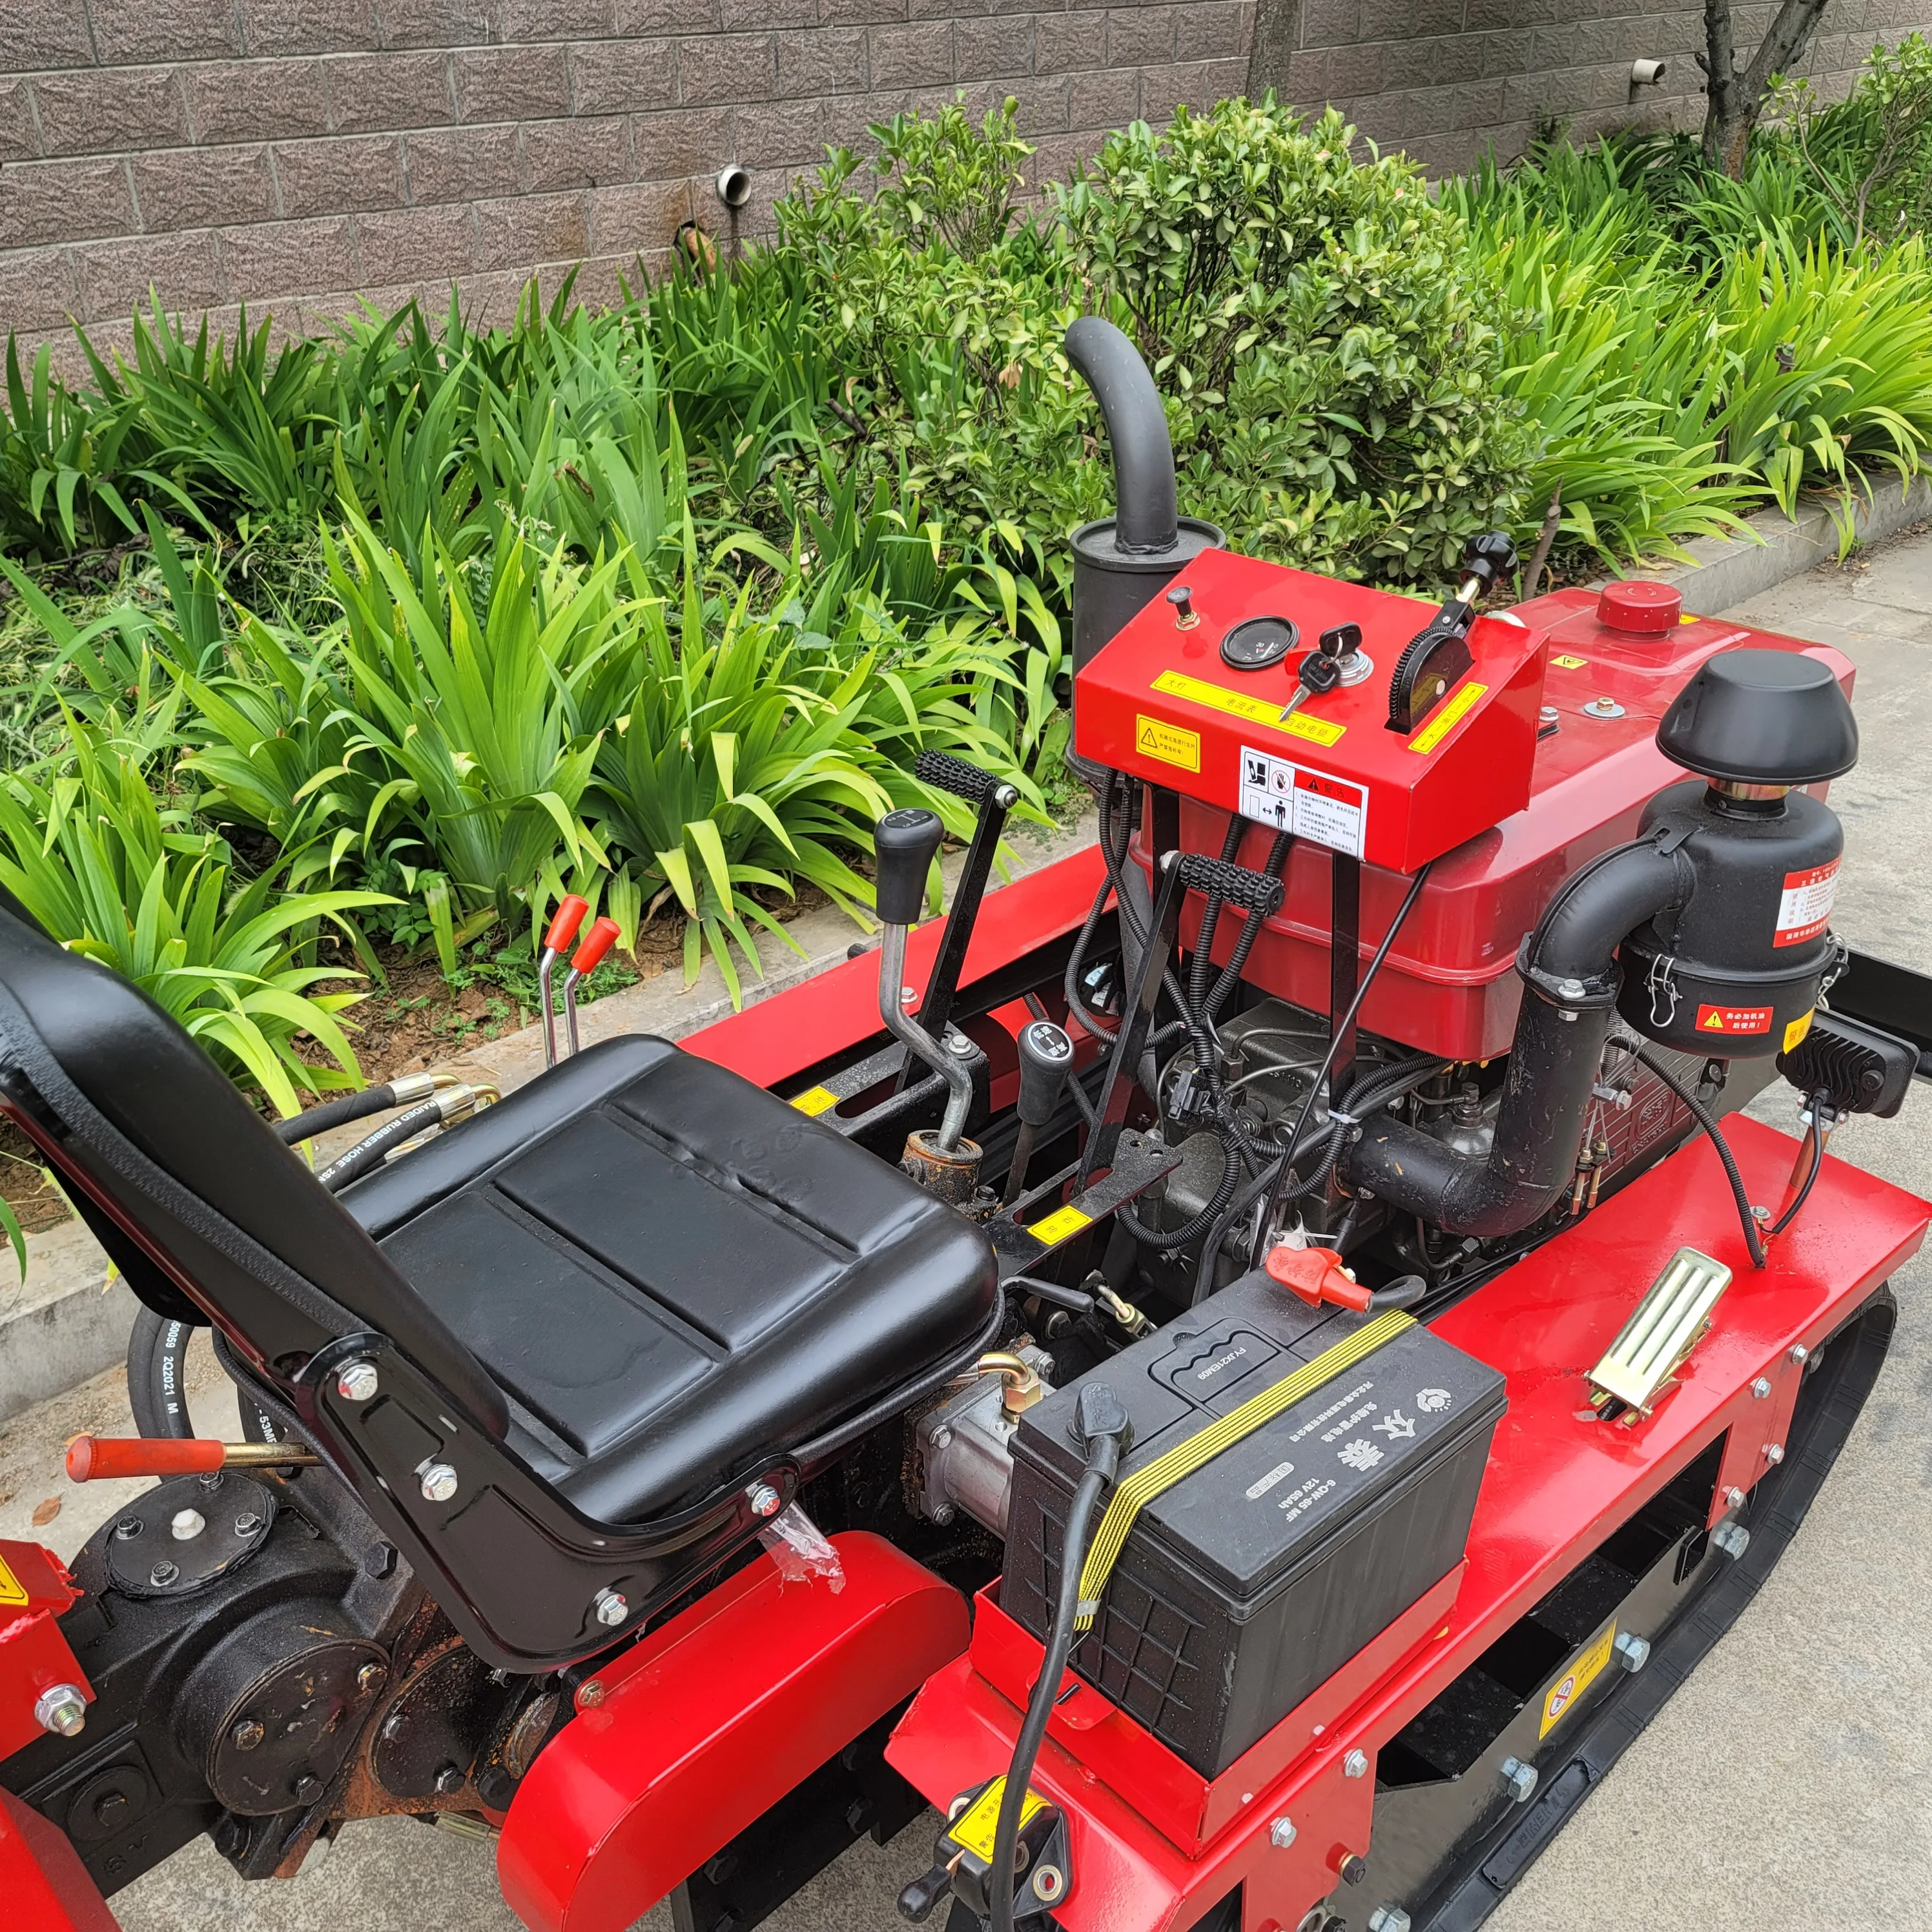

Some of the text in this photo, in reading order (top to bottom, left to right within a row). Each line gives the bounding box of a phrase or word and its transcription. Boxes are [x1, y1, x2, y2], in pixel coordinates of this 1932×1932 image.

[1164, 678, 1188, 690] 大灯
[1226, 697, 1258, 714] 电流表
[361, 1119, 402, 1148] RUBBER
[335, 1146, 365, 1168] HOSE
[163, 1321, 181, 1414] 50059 2Q2021 M
[1337, 1409, 1416, 1472] 众泰
[1249, 1464, 1291, 1495] 国标产品
[1278, 1477, 1320, 1510] 12V 65Ah
[1298, 1479, 1337, 1510] 6-QW-65
